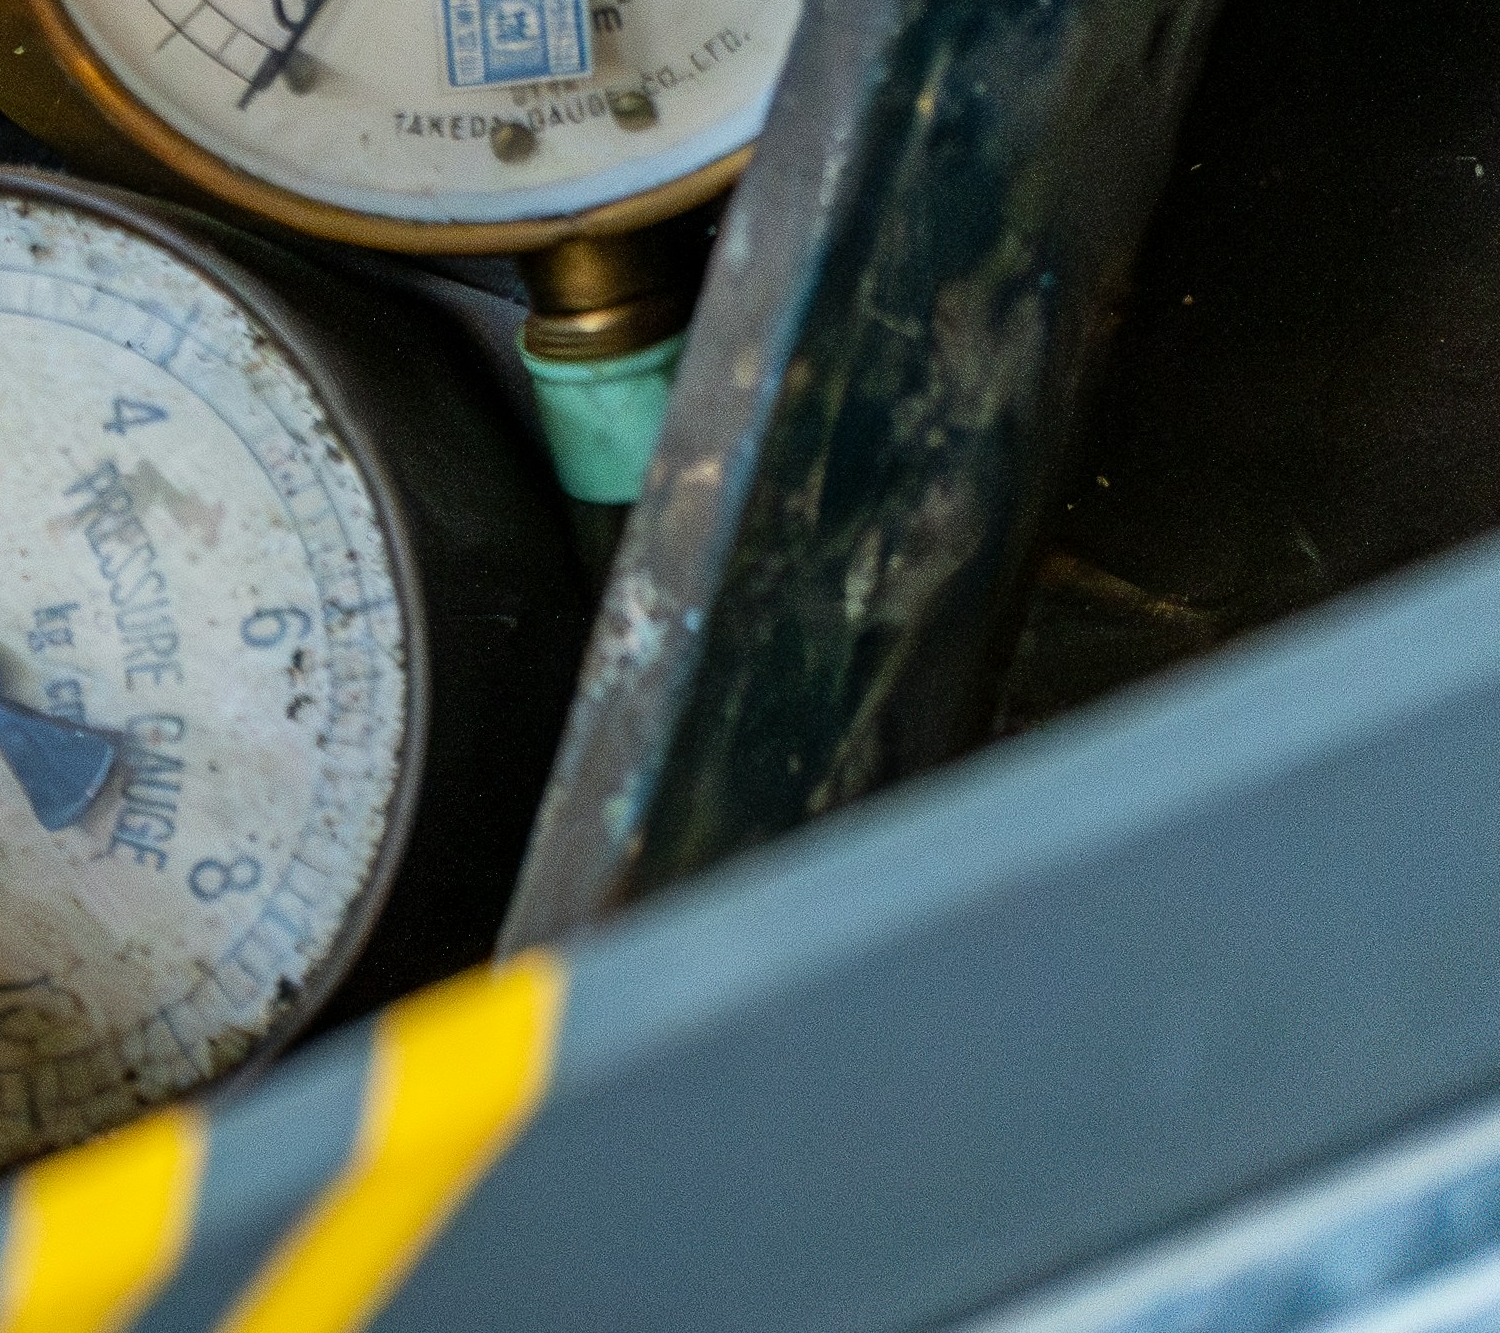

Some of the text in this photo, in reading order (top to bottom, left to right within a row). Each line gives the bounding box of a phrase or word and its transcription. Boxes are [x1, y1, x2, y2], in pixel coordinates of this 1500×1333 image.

[102, 395, 170, 437] 4
[240, 603, 314, 648] 6
[64, 458, 186, 870] PRESSURE GAUGE
[189, 855, 263, 902] 8
